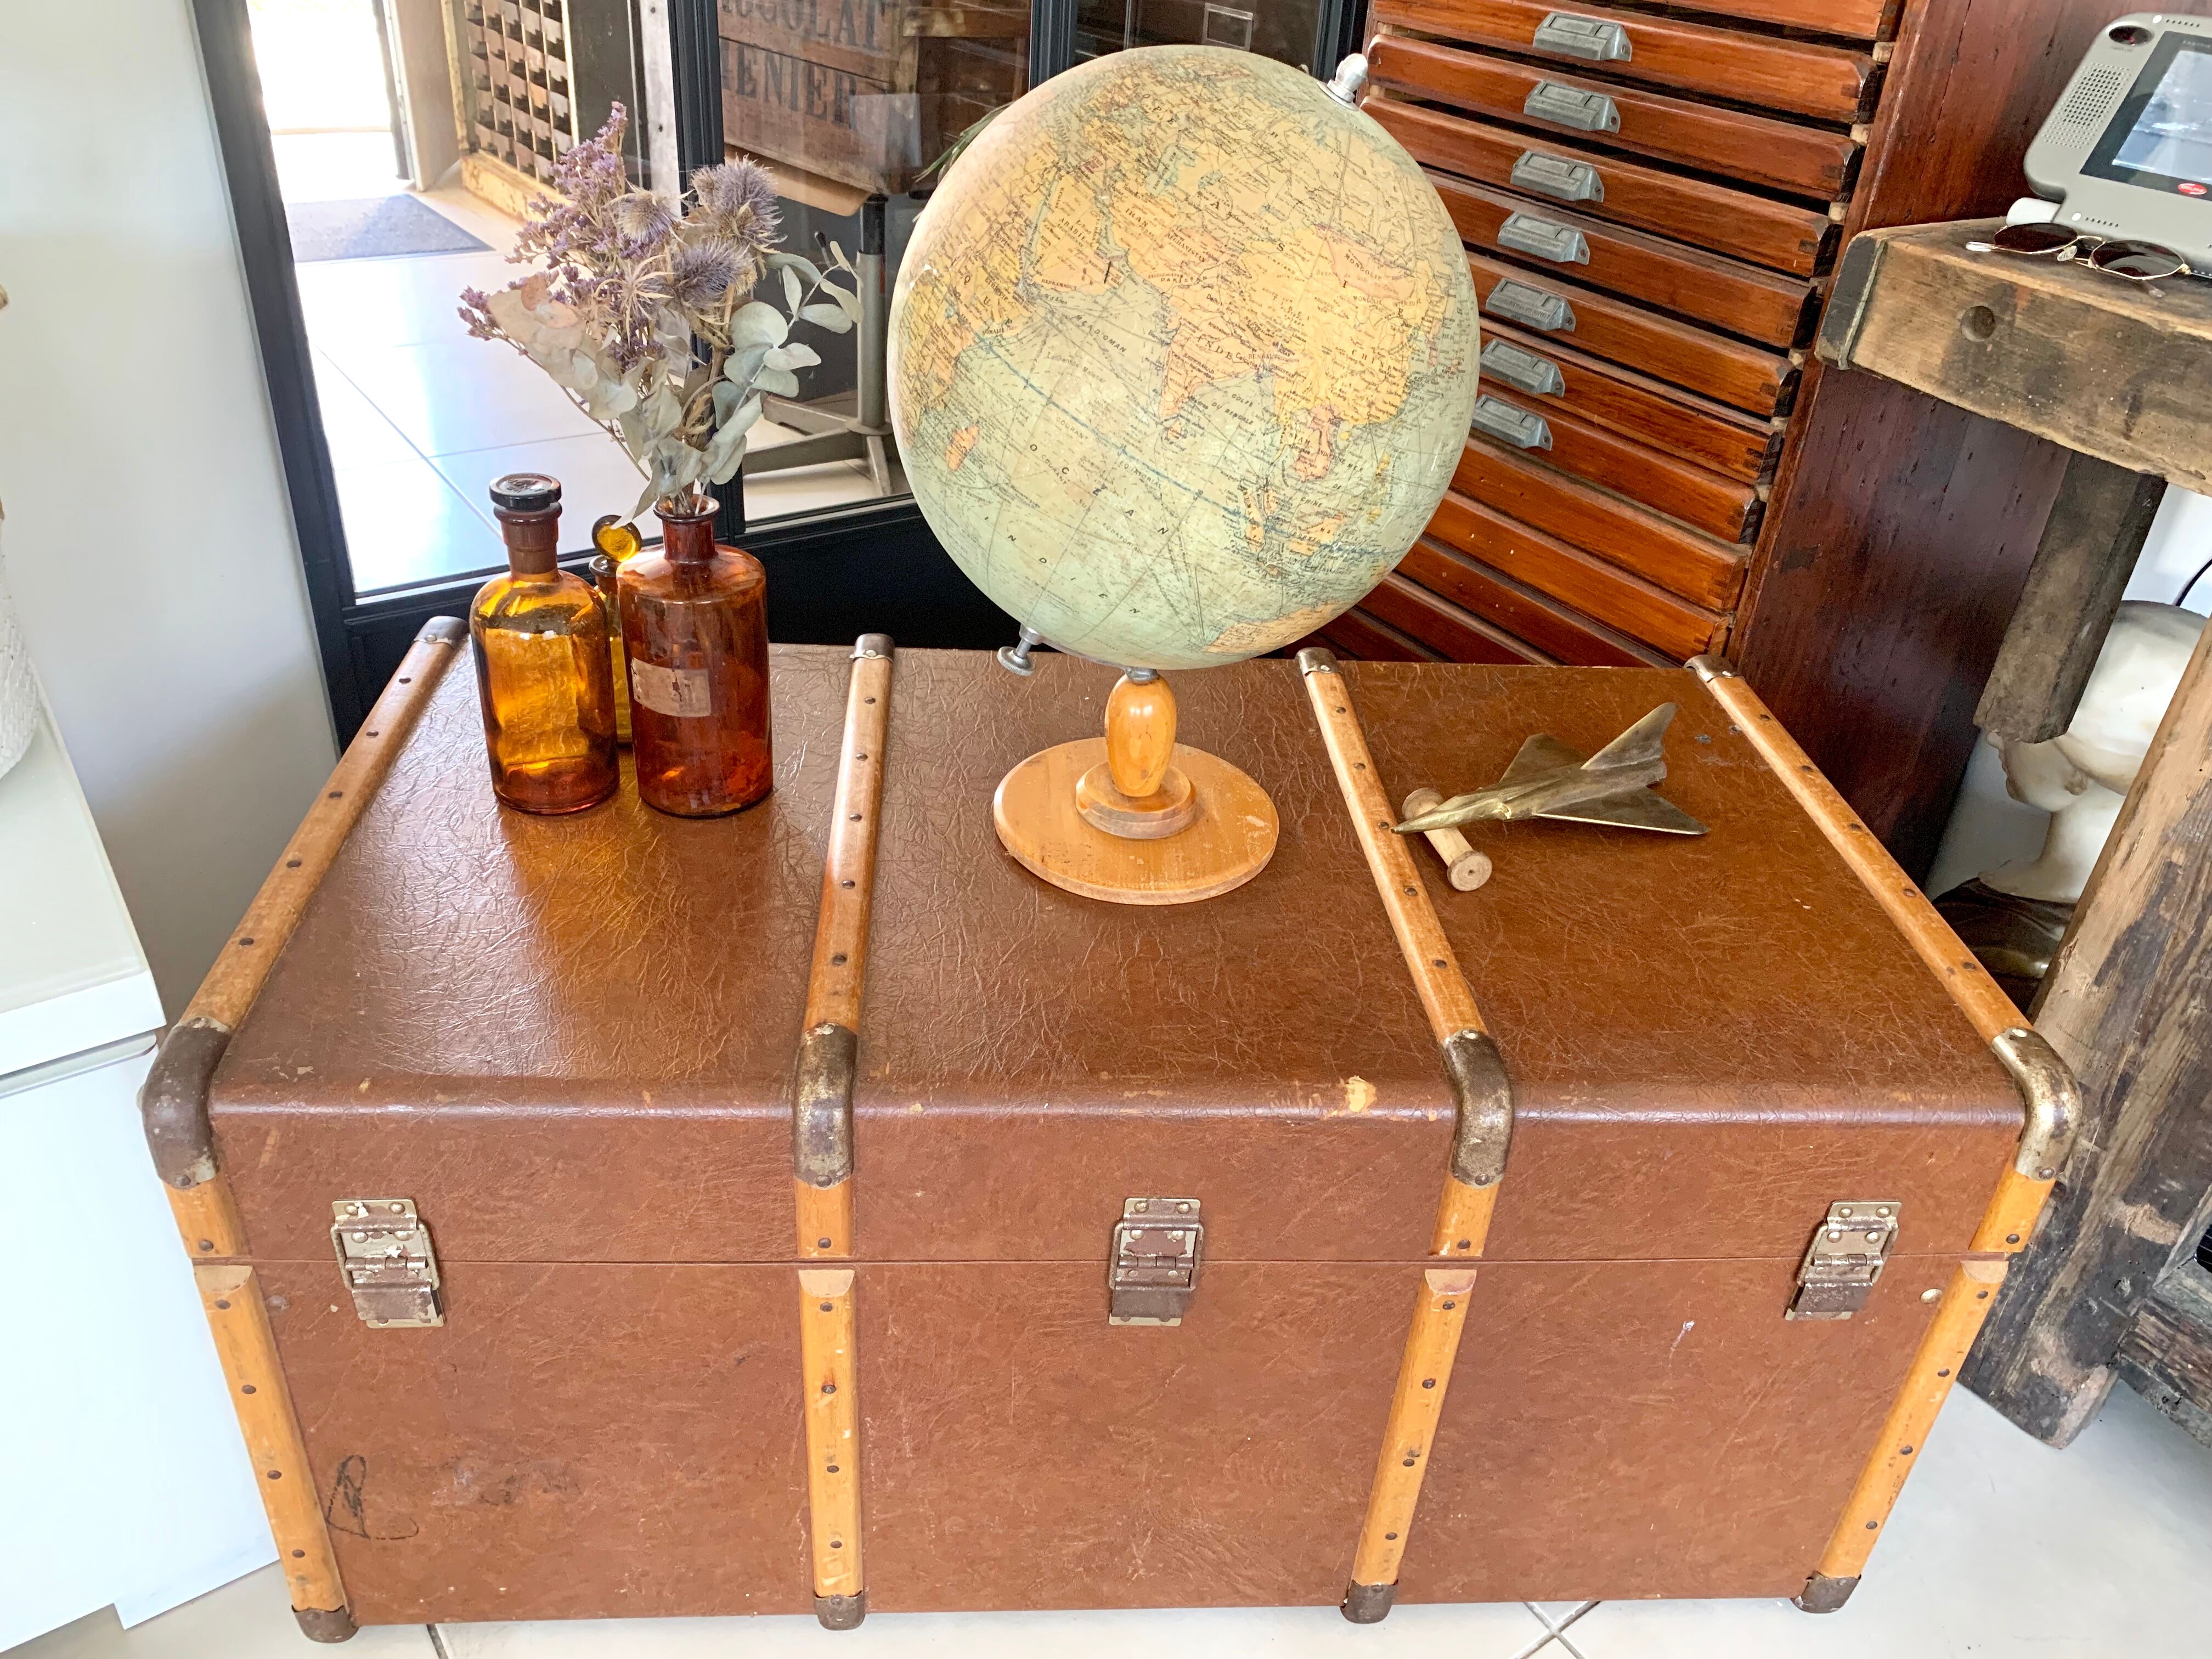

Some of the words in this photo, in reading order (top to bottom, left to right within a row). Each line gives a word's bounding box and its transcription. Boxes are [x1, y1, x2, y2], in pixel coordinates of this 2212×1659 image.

[1125, 208, 1148, 228] IRAN
[1059, 218, 1086, 241] ARABIE
[1164, 233, 1206, 263] AFGHANISTAN
[1344, 253, 1382, 281] MONGOLIE
[1160, 275, 1208, 284] PAKISTAN
[1353, 295, 1382, 305] MONGOLIE
[1076, 314, 1093, 330] MER
[1197, 335, 1235, 360] INDE
[1231, 393, 1254, 407] GOLFE
[1211, 401, 1222, 410] DU
[1224, 408, 1254, 425] BENGALE
[1056, 415, 1088, 439] COURANT
[1041, 454, 1069, 486] COURANT
[1346, 462, 1363, 473] MER
[1300, 496, 1323, 508] CHINE
